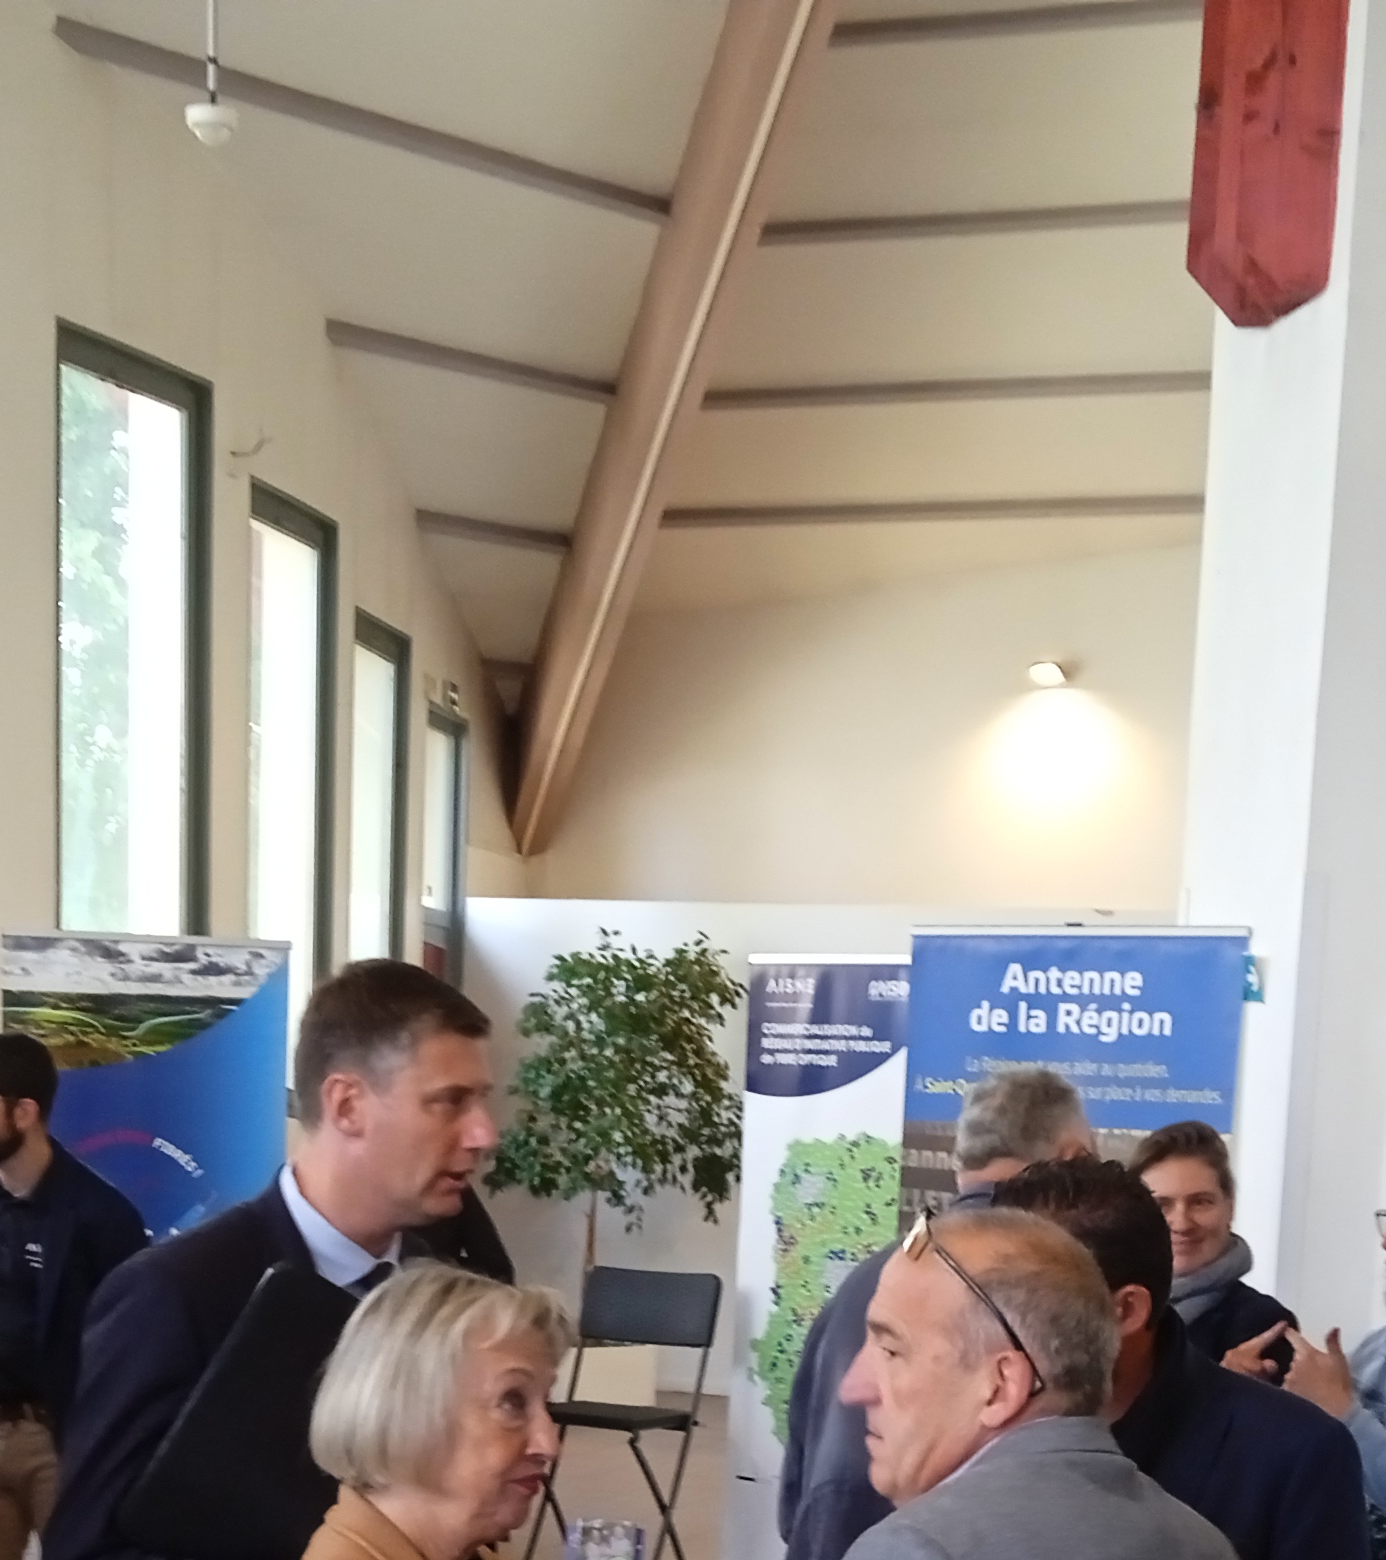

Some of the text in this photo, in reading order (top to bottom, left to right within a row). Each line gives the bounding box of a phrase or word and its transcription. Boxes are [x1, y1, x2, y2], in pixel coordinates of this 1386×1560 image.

[1000, 963, 1143, 996] Antenne
[970, 1002, 1172, 1043] de la Région
